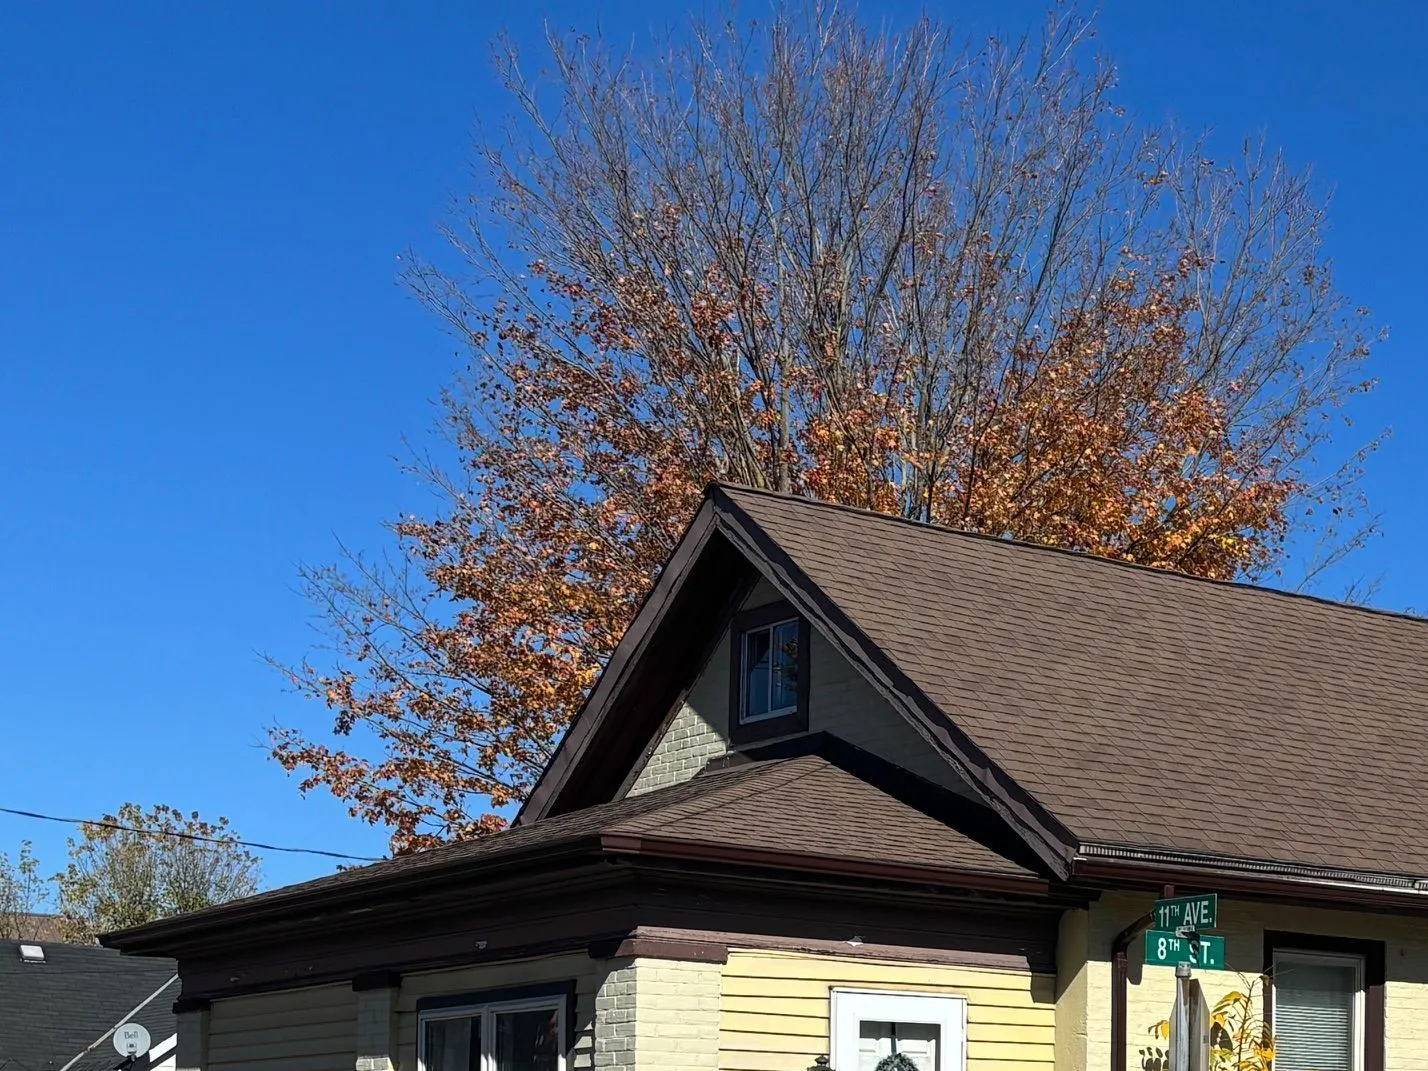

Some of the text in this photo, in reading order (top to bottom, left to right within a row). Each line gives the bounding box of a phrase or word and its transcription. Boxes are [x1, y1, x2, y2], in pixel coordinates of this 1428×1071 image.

[1159, 900, 1213, 928] 11TH AVE.
[1157, 937, 1180, 960] 8TH
